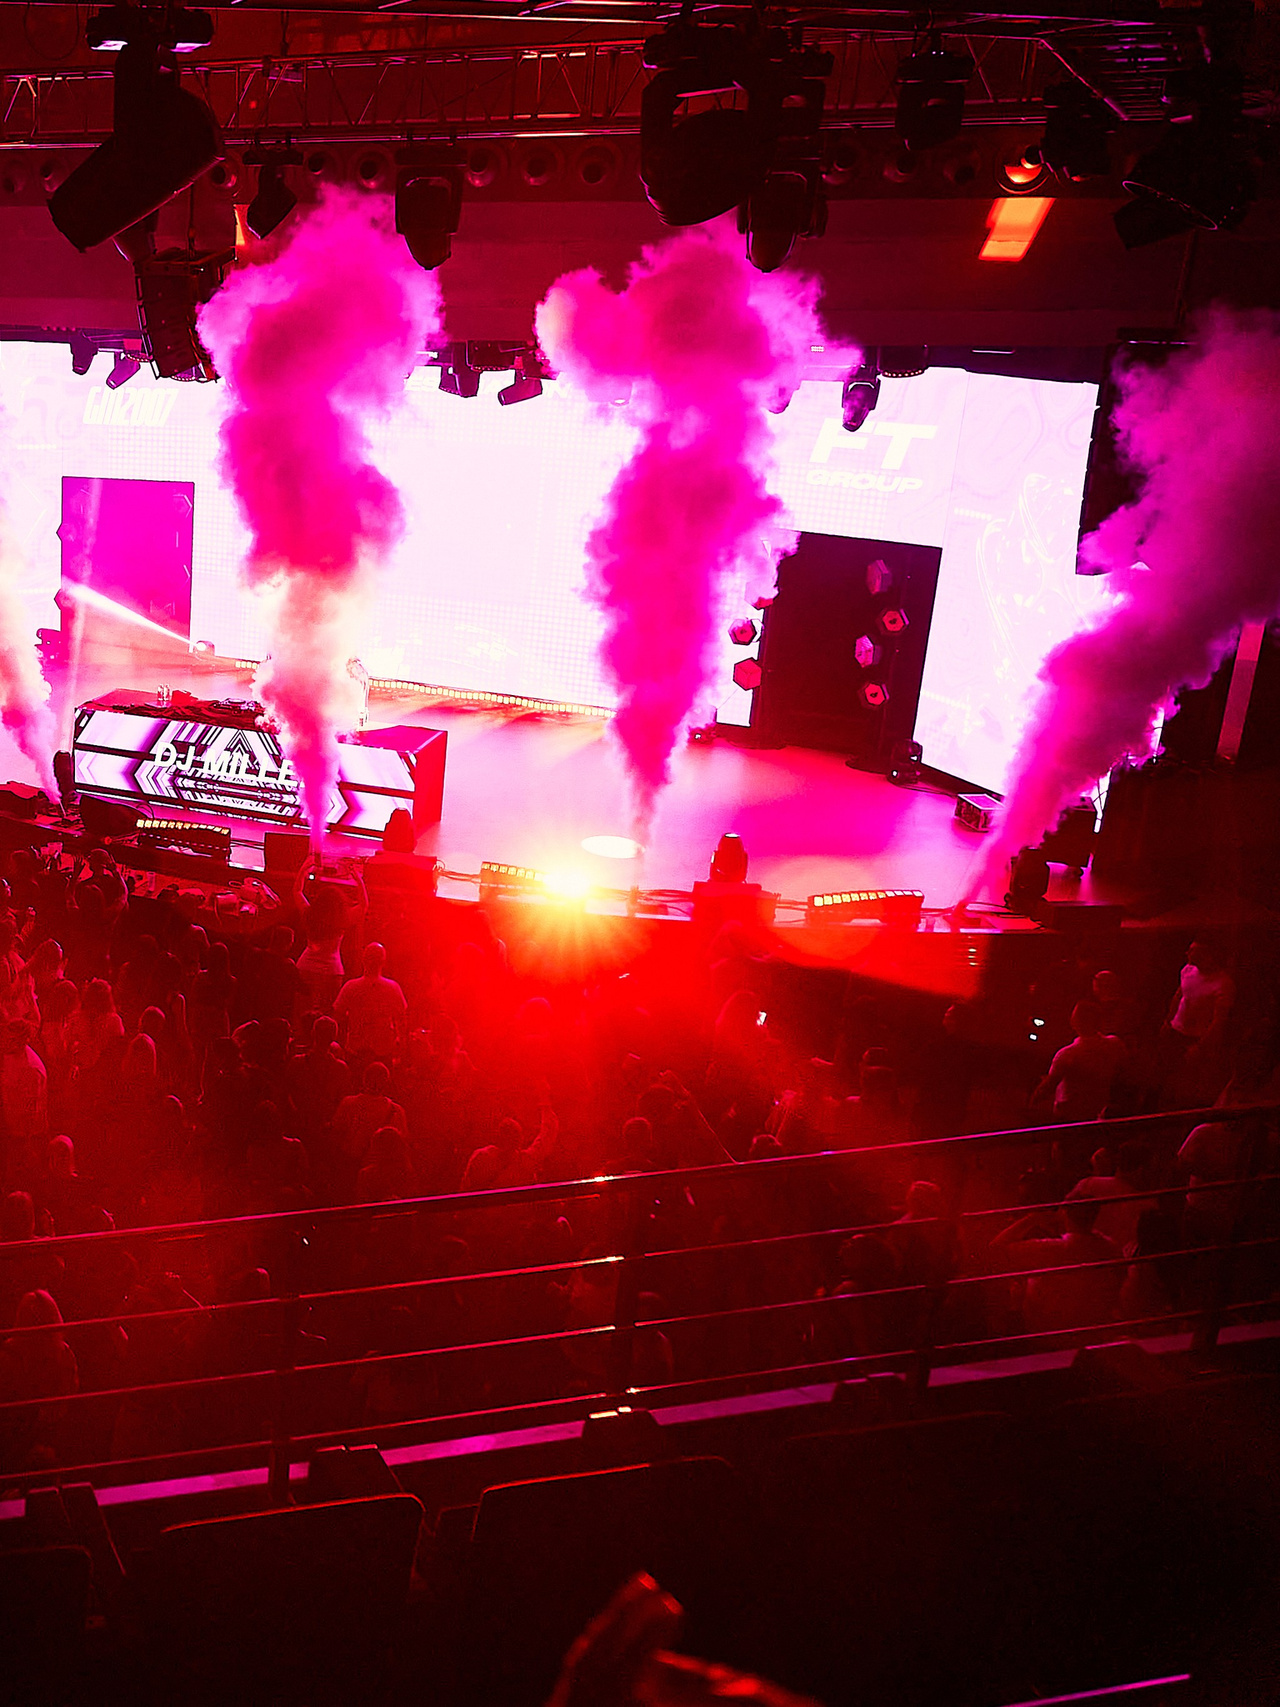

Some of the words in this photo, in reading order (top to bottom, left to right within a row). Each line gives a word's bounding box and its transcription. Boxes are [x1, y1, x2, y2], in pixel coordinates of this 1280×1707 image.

[808, 417, 939, 471] FT
[805, 469, 924, 494] GROUP
[153, 741, 197, 771] DJ
[203, 749, 306, 789] MILLE
